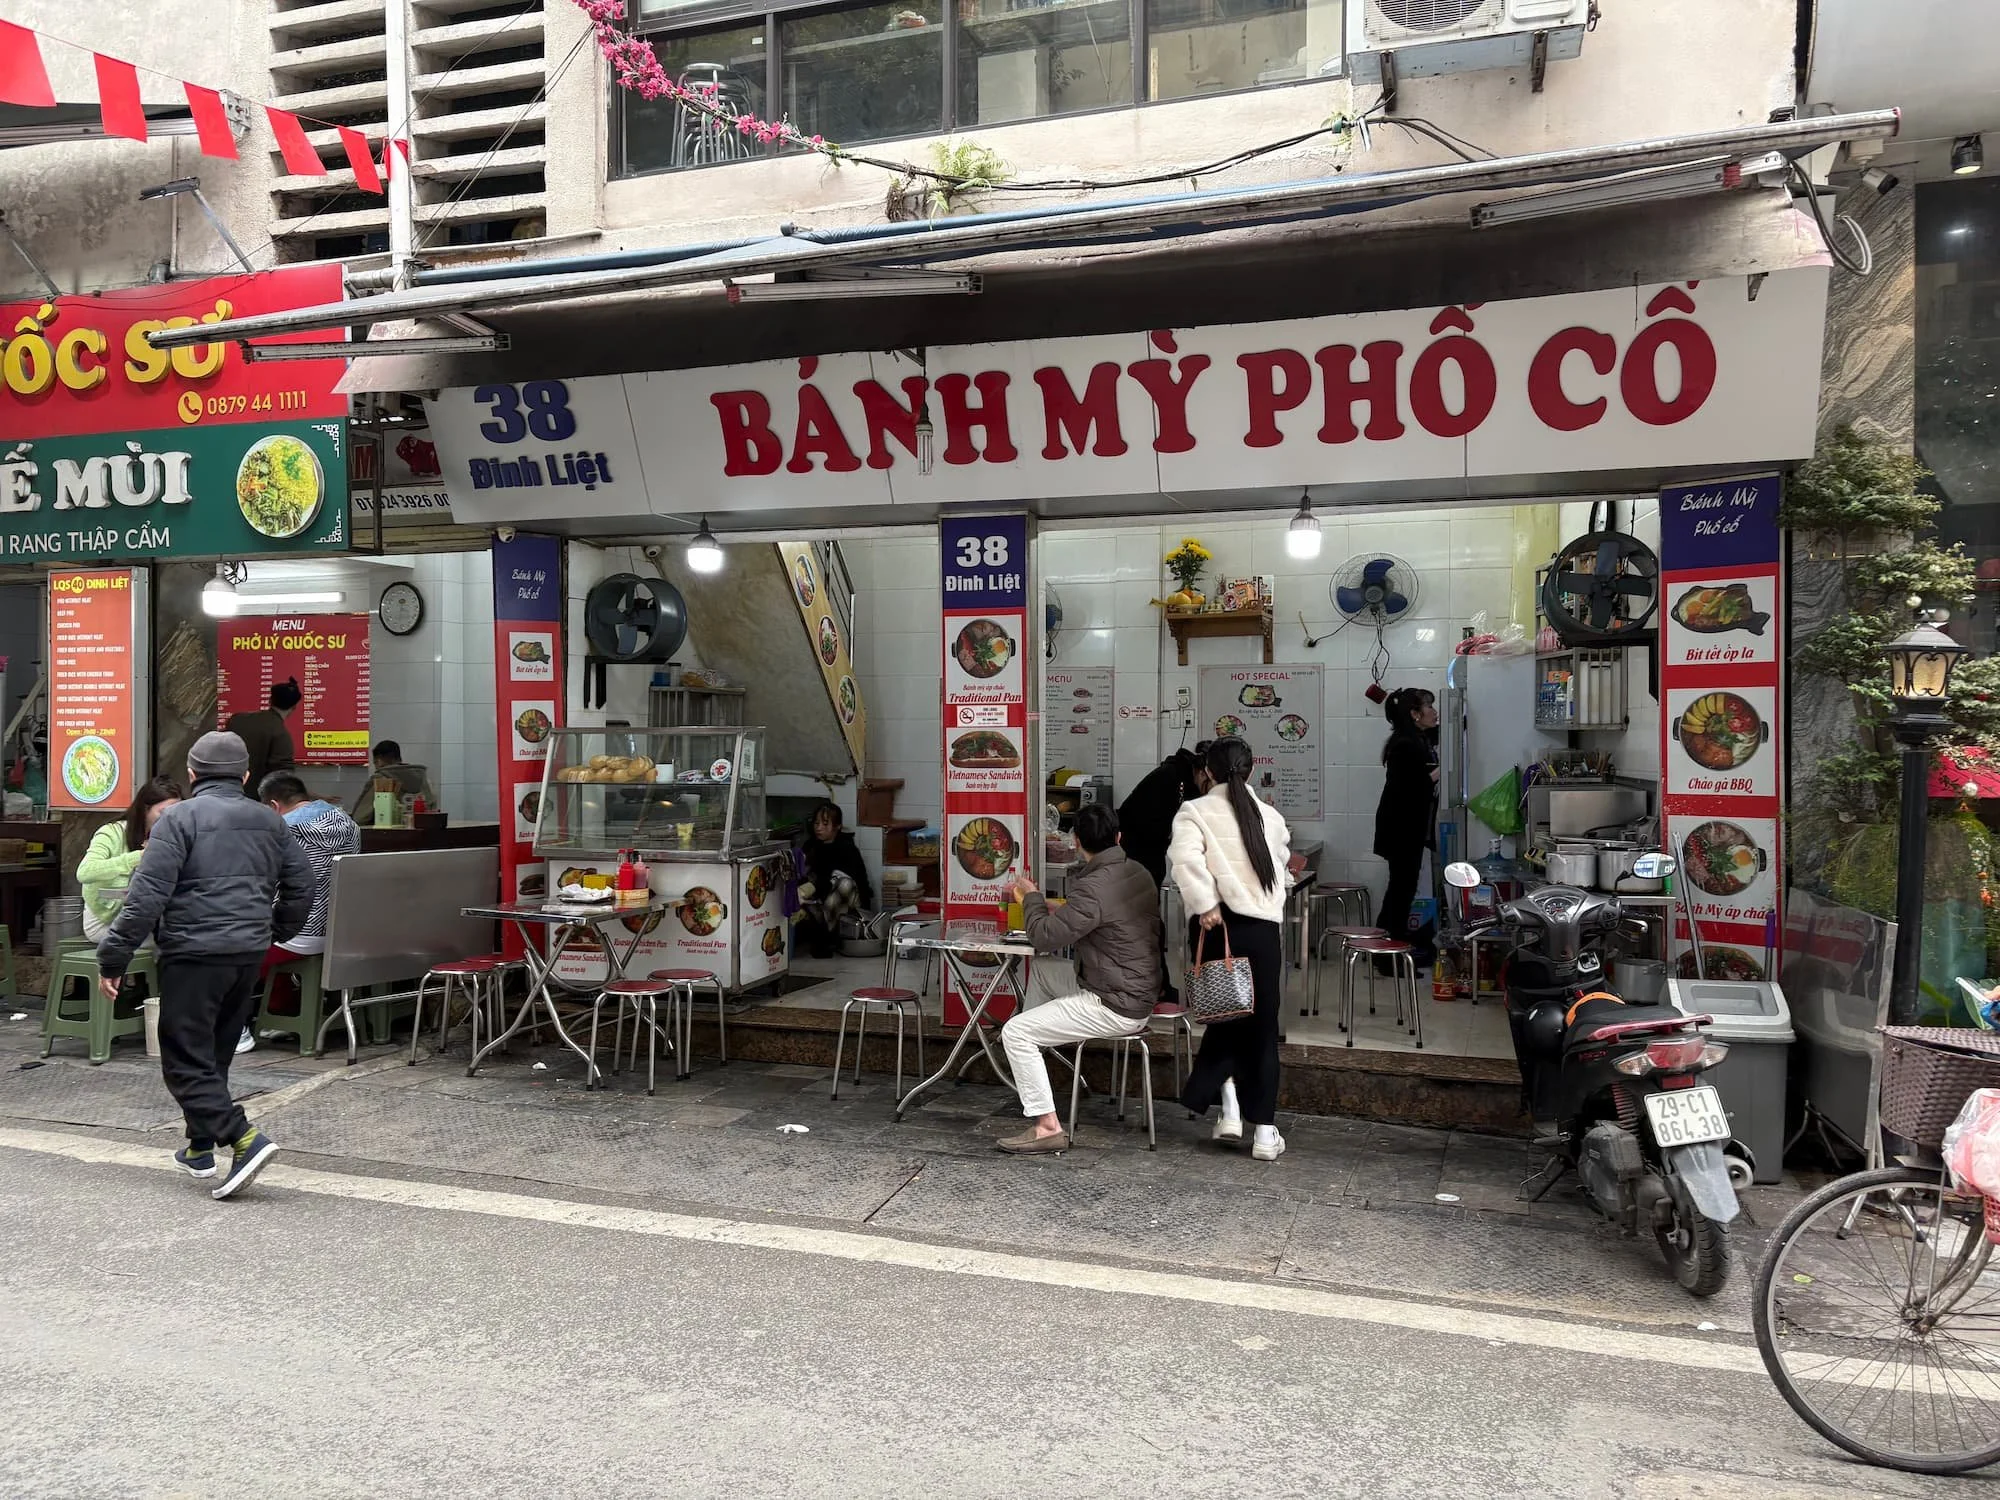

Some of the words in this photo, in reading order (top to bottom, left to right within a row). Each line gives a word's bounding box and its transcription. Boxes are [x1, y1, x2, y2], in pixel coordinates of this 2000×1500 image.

[207, 397, 246, 415] 0879
[251, 393, 273, 412] 44
[278, 390, 307, 409] 1111
[473, 380, 577, 443] 38
[710, 355, 1018, 477] BÁNH
[52, 440, 193, 510] MÙI
[468, 455, 543, 490] Đinh
[545, 451, 613, 491] Liệt
[1679, 491, 1724, 511] Bánh
[1693, 516, 1725, 536] Phố
[9, 533, 61, 555] RANG
[67, 526, 118, 554] THẬP
[124, 520, 170, 550] CẨM
[956, 535, 1009, 568] 38
[945, 574, 984, 592] Đinh
[988, 572, 1021, 593] Liệt
[272, 619, 306, 631] MENU
[232, 635, 261, 650] PHỞ
[264, 632, 280, 650] LÝ
[282, 631, 324, 650] QUỐC
[327, 634, 347, 649] SƯ
[1741, 646, 1754, 659] la
[1231, 672, 1250, 680] HOT
[1255, 671, 1291, 680] SPECIAL
[950, 692, 1001, 703] Traditional
[1003, 692, 1021, 702] Pan
[1252, 756, 1274, 765] RINK
[949, 770, 988, 780] Vietnamese
[989, 770, 1022, 780] Sandwich
[1730, 778, 1753, 793] BBQ
[950, 892, 977, 901] Roasted
[678, 939, 713, 947] Traditional
[714, 940, 727, 948] Pan
[1656, 1091, 1710, 1119] 29-C1
[1658, 1114, 1724, 1144] 864.38
